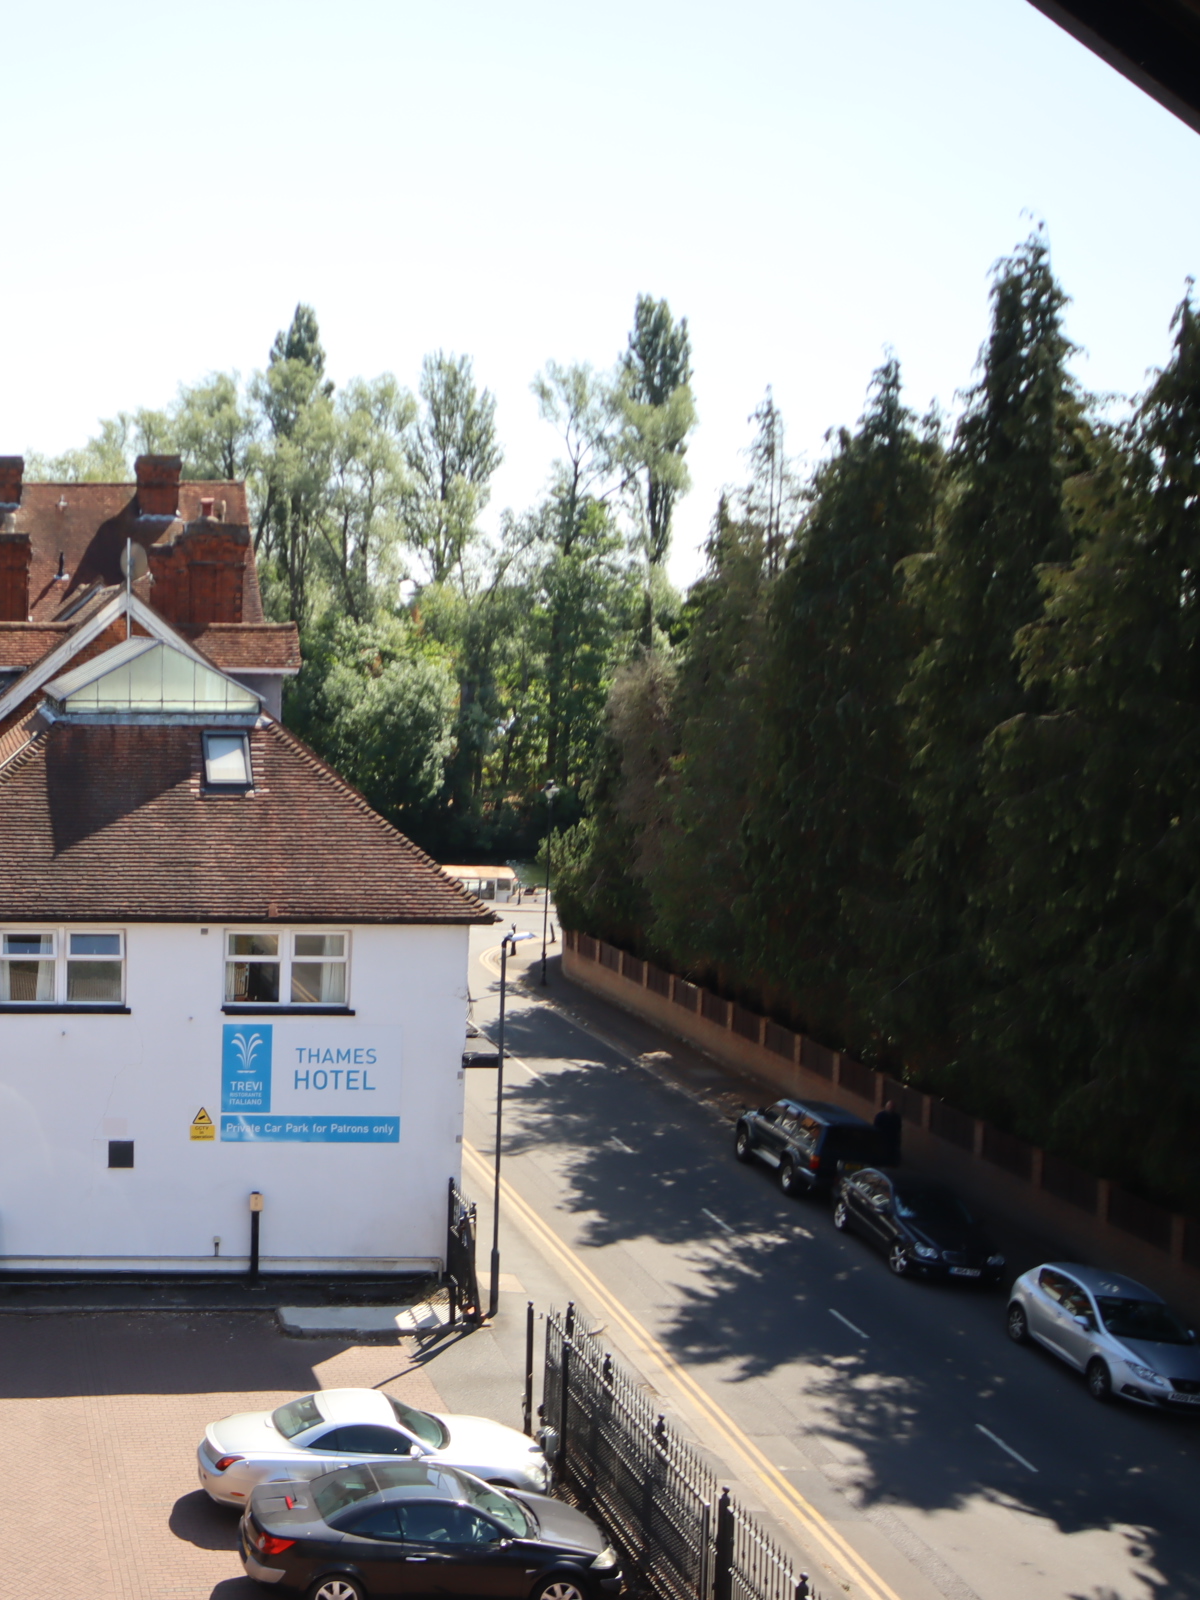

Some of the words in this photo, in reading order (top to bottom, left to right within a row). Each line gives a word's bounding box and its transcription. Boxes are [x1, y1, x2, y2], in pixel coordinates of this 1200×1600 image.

[295, 1047, 377, 1064] THAMES
[294, 1069, 376, 1090] HOTEL
[230, 1081, 263, 1092] TREVI
[229, 1098, 263, 1106] ITALIANO
[226, 1123, 261, 1133] Private
[264, 1123, 282, 1133] Car
[285, 1123, 309, 1133] Park
[312, 1123, 327, 1133] for
[330, 1123, 369, 1133] Patrons
[372, 1124, 394, 1136] only
